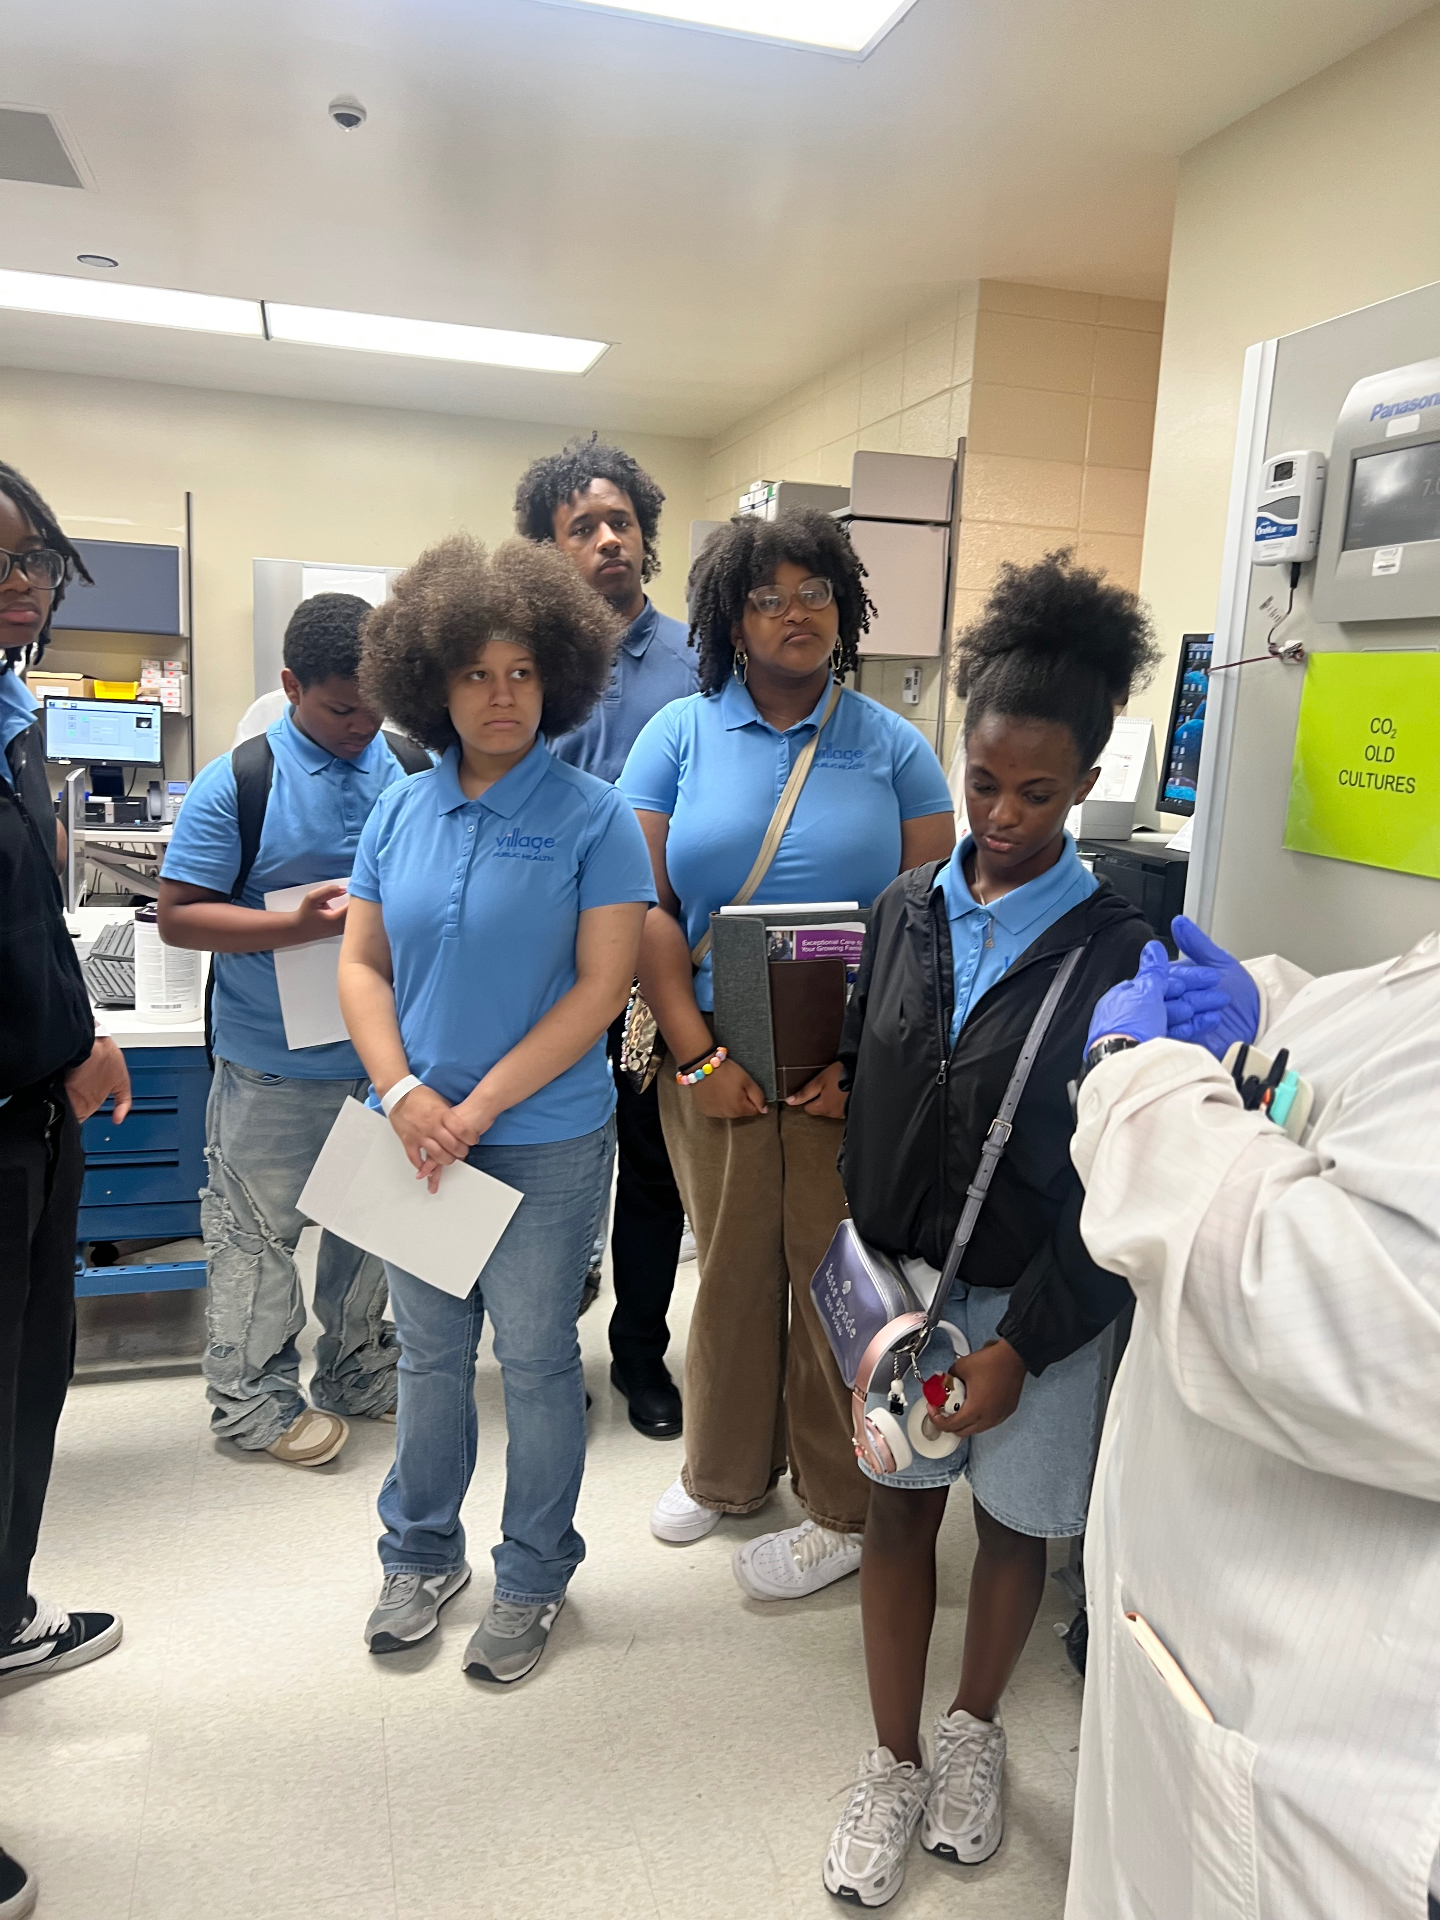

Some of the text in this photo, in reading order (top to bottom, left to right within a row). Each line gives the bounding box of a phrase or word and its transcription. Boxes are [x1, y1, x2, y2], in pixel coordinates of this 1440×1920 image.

[1364, 744, 1395, 763] OLD
[1338, 769, 1416, 794] CULTURES
[495, 827, 556, 855] village
[521, 853, 554, 861] HEALTH
[840, 938, 856, 946] Care
